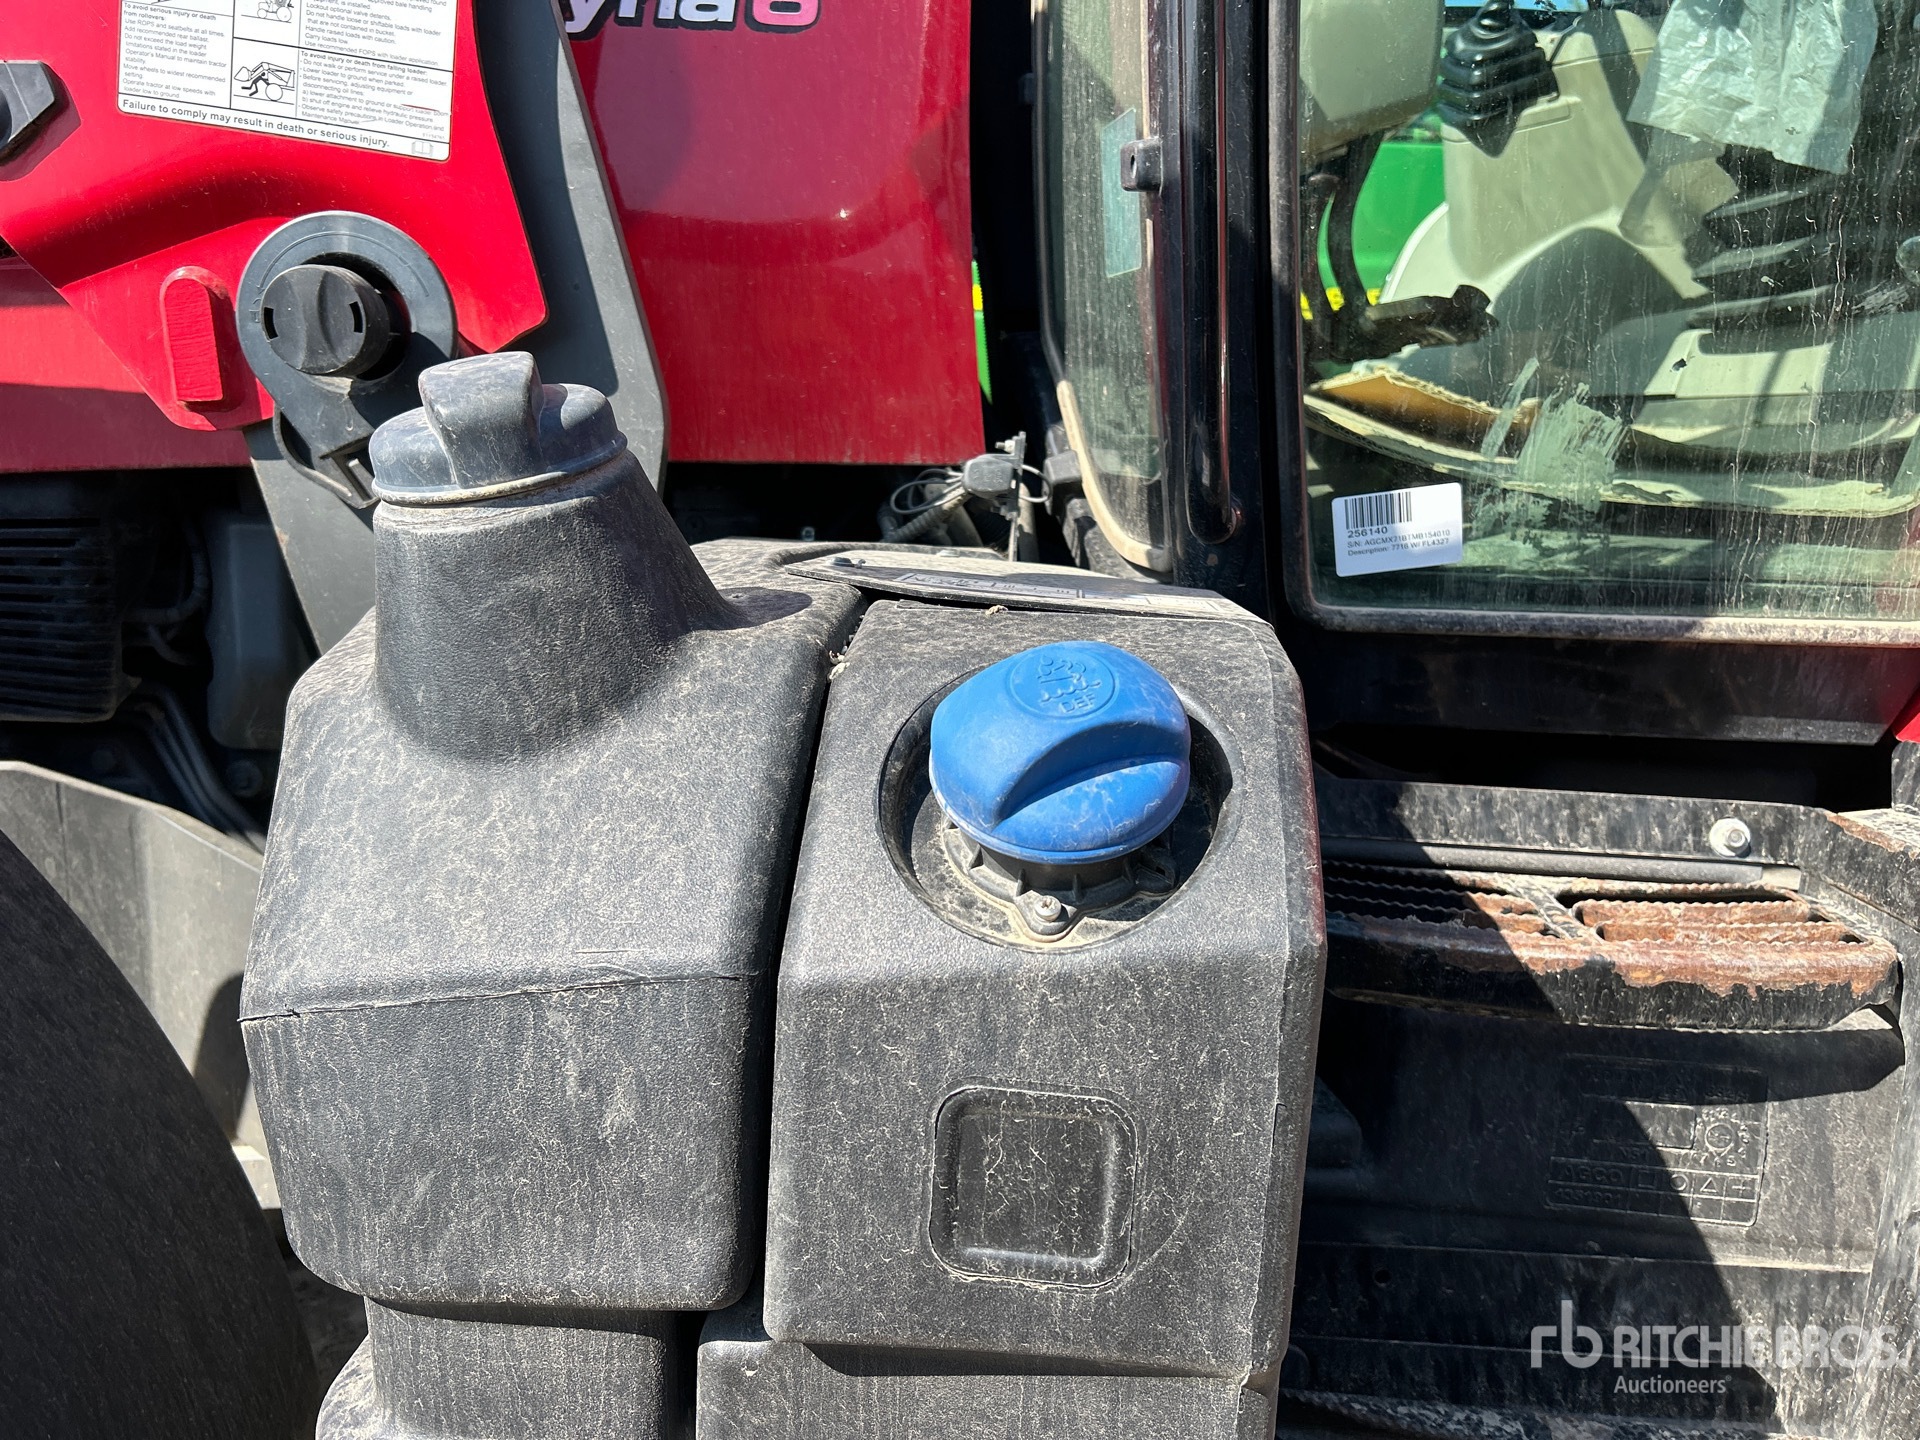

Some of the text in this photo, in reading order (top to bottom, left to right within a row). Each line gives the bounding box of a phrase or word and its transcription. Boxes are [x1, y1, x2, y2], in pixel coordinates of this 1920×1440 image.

[122, 99, 391, 149] Failure to comply may result in death or serious injury.
[1347, 526, 1388, 539] 256140
[1347, 546, 1388, 557] Description:
[1391, 543, 1409, 551] 7716
[1422, 538, 1449, 548] FL4327
[1058, 693, 1096, 714] DEF
